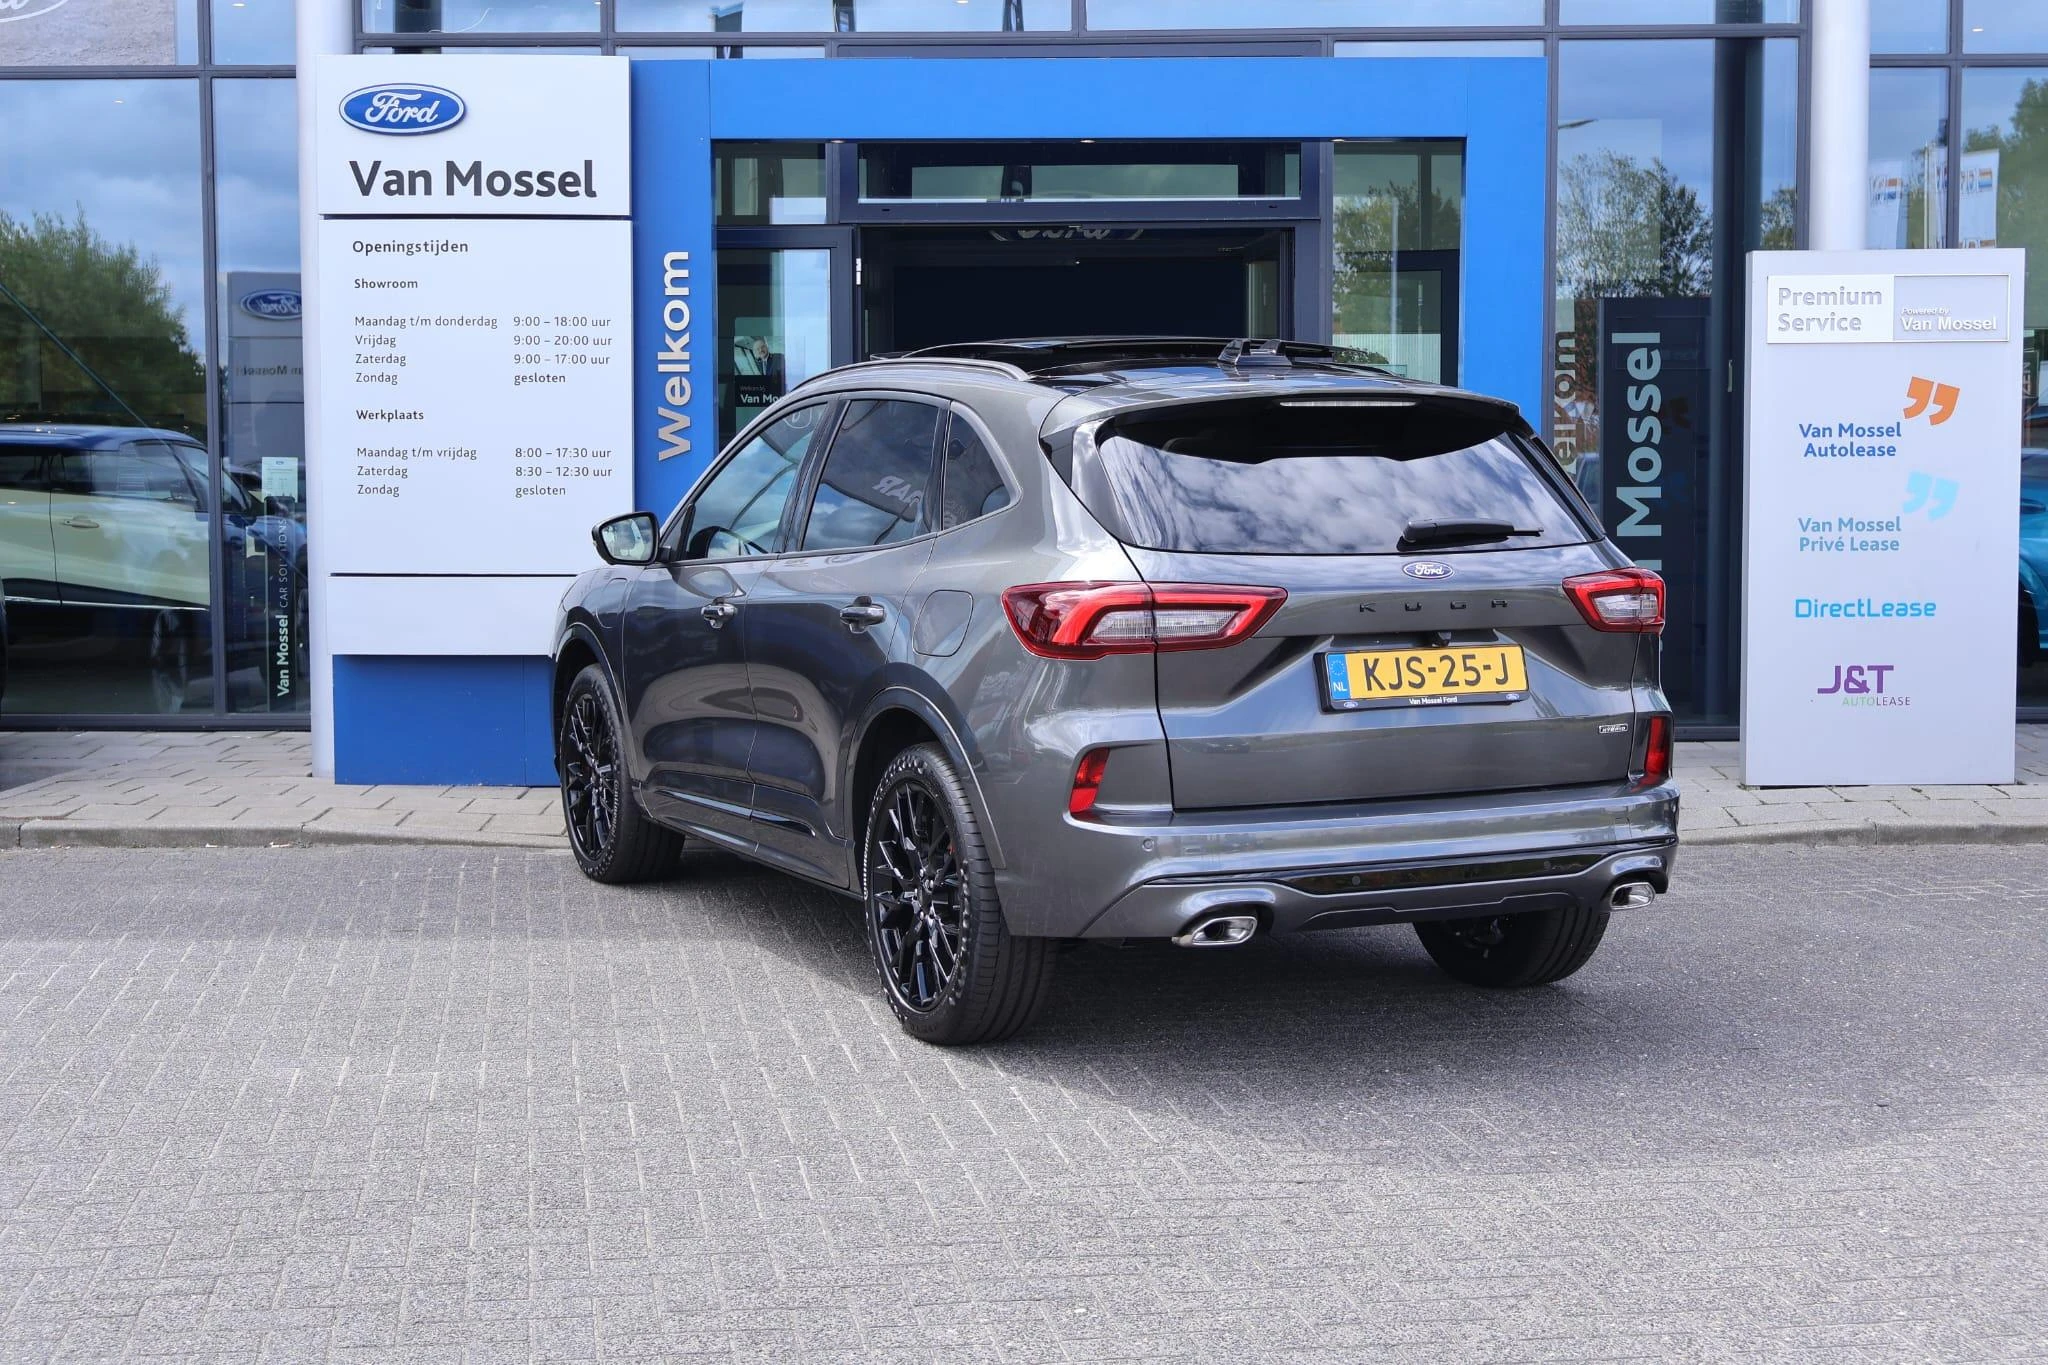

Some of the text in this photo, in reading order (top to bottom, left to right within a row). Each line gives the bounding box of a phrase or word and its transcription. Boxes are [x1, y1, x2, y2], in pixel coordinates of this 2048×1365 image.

[365, 91, 440, 123] Ford
[349, 159, 597, 198] Van Mossel
[352, 240, 468, 256] Openingstijden
[354, 278, 418, 289] Showroom
[1778, 286, 1882, 306] Premium
[355, 316, 498, 329] Maandag t/m donderdag
[513, 317, 540, 327] 9:00
[553, 316, 588, 327] 18:00
[591, 318, 611, 327] uur
[1777, 312, 1862, 332] Service
[1901, 316, 1997, 331] Van Mossel
[355, 335, 396, 348] Vrijdag
[513, 336, 541, 346] 9:00
[554, 335, 589, 346] 20:00
[592, 337, 612, 346] uur
[355, 353, 407, 367] Zaterdag
[514, 354, 541, 365] 9:00
[555, 354, 587, 365] 17:00
[590, 356, 610, 365] uur
[657, 251, 692, 461] Welkom
[355, 372, 398, 385] Zondag
[514, 372, 566, 385] gesloten
[740, 394, 760, 403] Van
[1554, 331, 1577, 474] elkom
[356, 409, 424, 423] Werkplaats
[1612, 332, 1662, 536] Mossel
[1799, 422, 1902, 438] Van Mossel
[357, 447, 477, 460] Maandag t/m vrijdag
[515, 448, 542, 458] 8:00
[556, 447, 589, 458] 17:30
[591, 450, 612, 458] uur
[1804, 442, 1897, 458] Autolease
[357, 465, 409, 479] Zaterdag
[515, 466, 542, 477] 8:30
[556, 466, 590, 477] 12:30
[593, 469, 613, 477] uur
[357, 484, 400, 497] Zondag
[515, 485, 566, 498] gesloten
[1798, 516, 1901, 532] Van Mossel
[1799, 535, 1899, 552] Privé Lease
[279, 586, 288, 608] CAR
[1795, 599, 1937, 618] DirectLease
[275, 614, 289, 665] Mossel
[1362, 653, 1509, 691] KJS-25-J
[1817, 664, 1894, 694] J&T
[277, 670, 290, 697] Van
[1333, 682, 1347, 692] NL
[1842, 696, 1911, 706] AUTOLEASE
